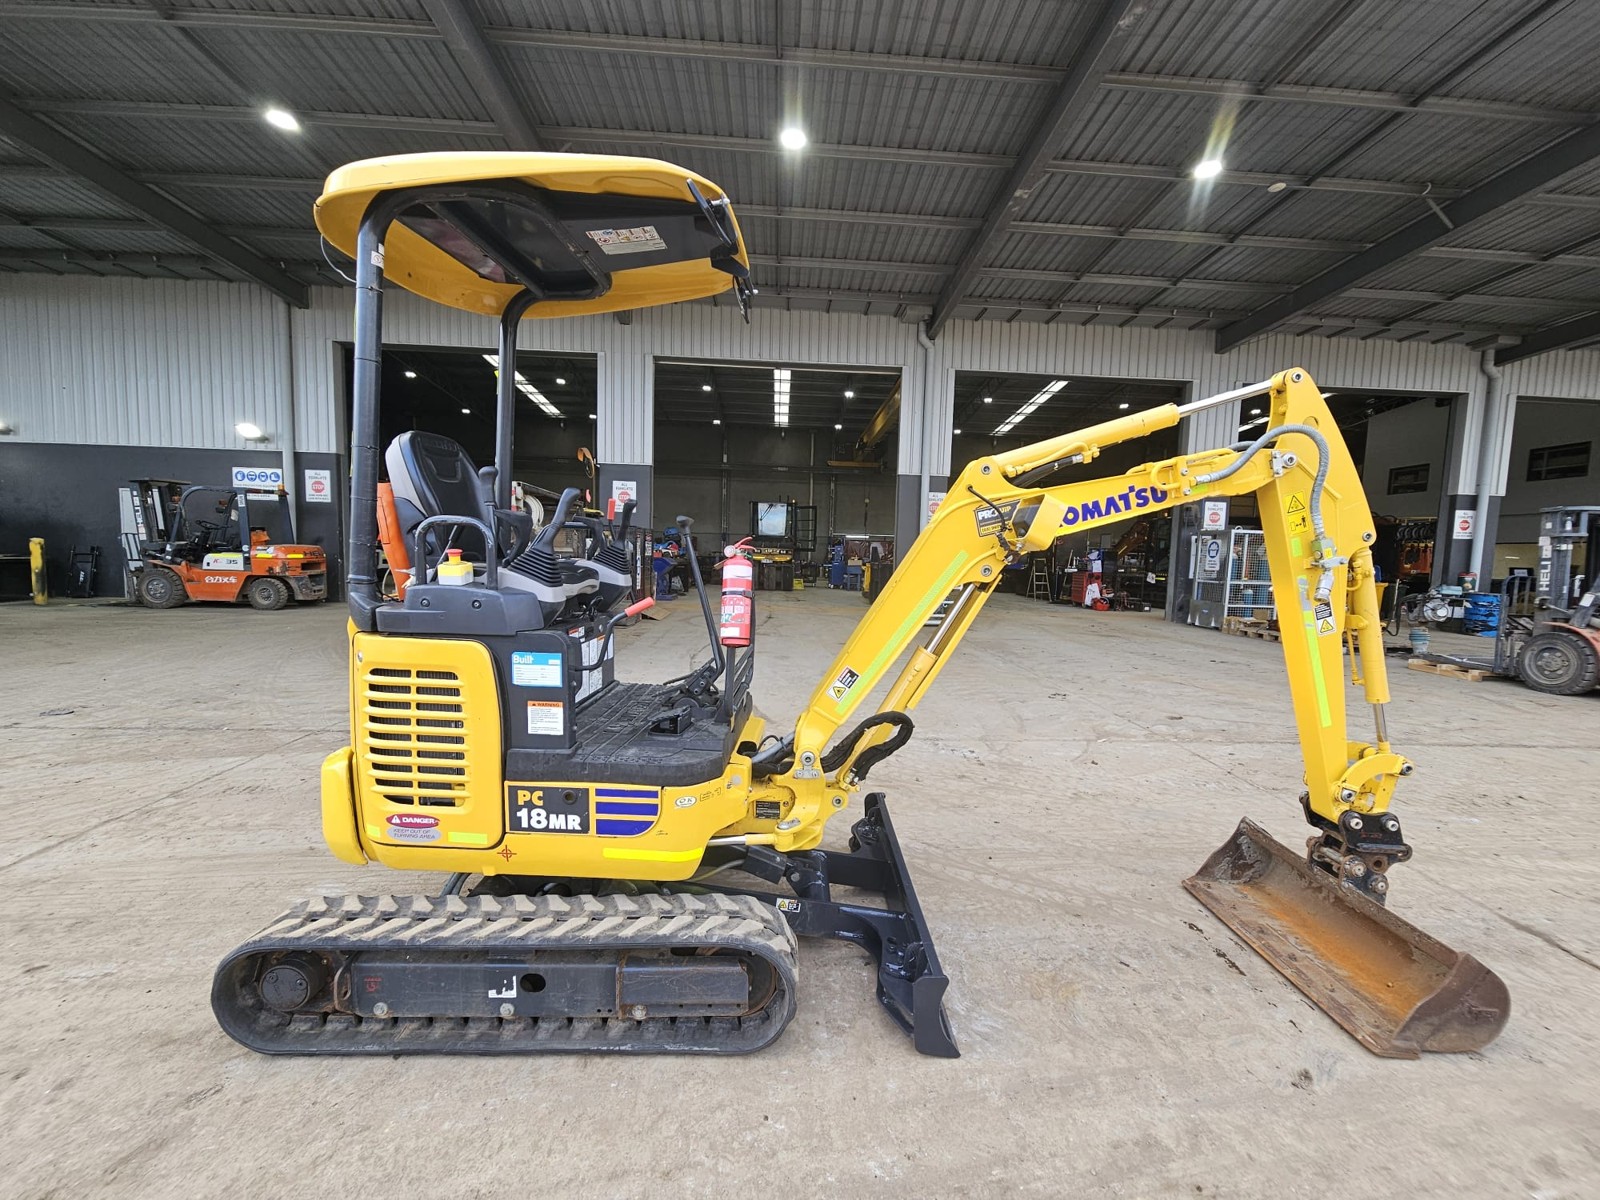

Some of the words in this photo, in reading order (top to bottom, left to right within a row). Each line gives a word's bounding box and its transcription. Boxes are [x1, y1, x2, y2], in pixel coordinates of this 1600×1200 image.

[1060, 485, 1168, 528] OMATSU
[1539, 561, 1551, 591] HELI
[517, 789, 544, 807] PC
